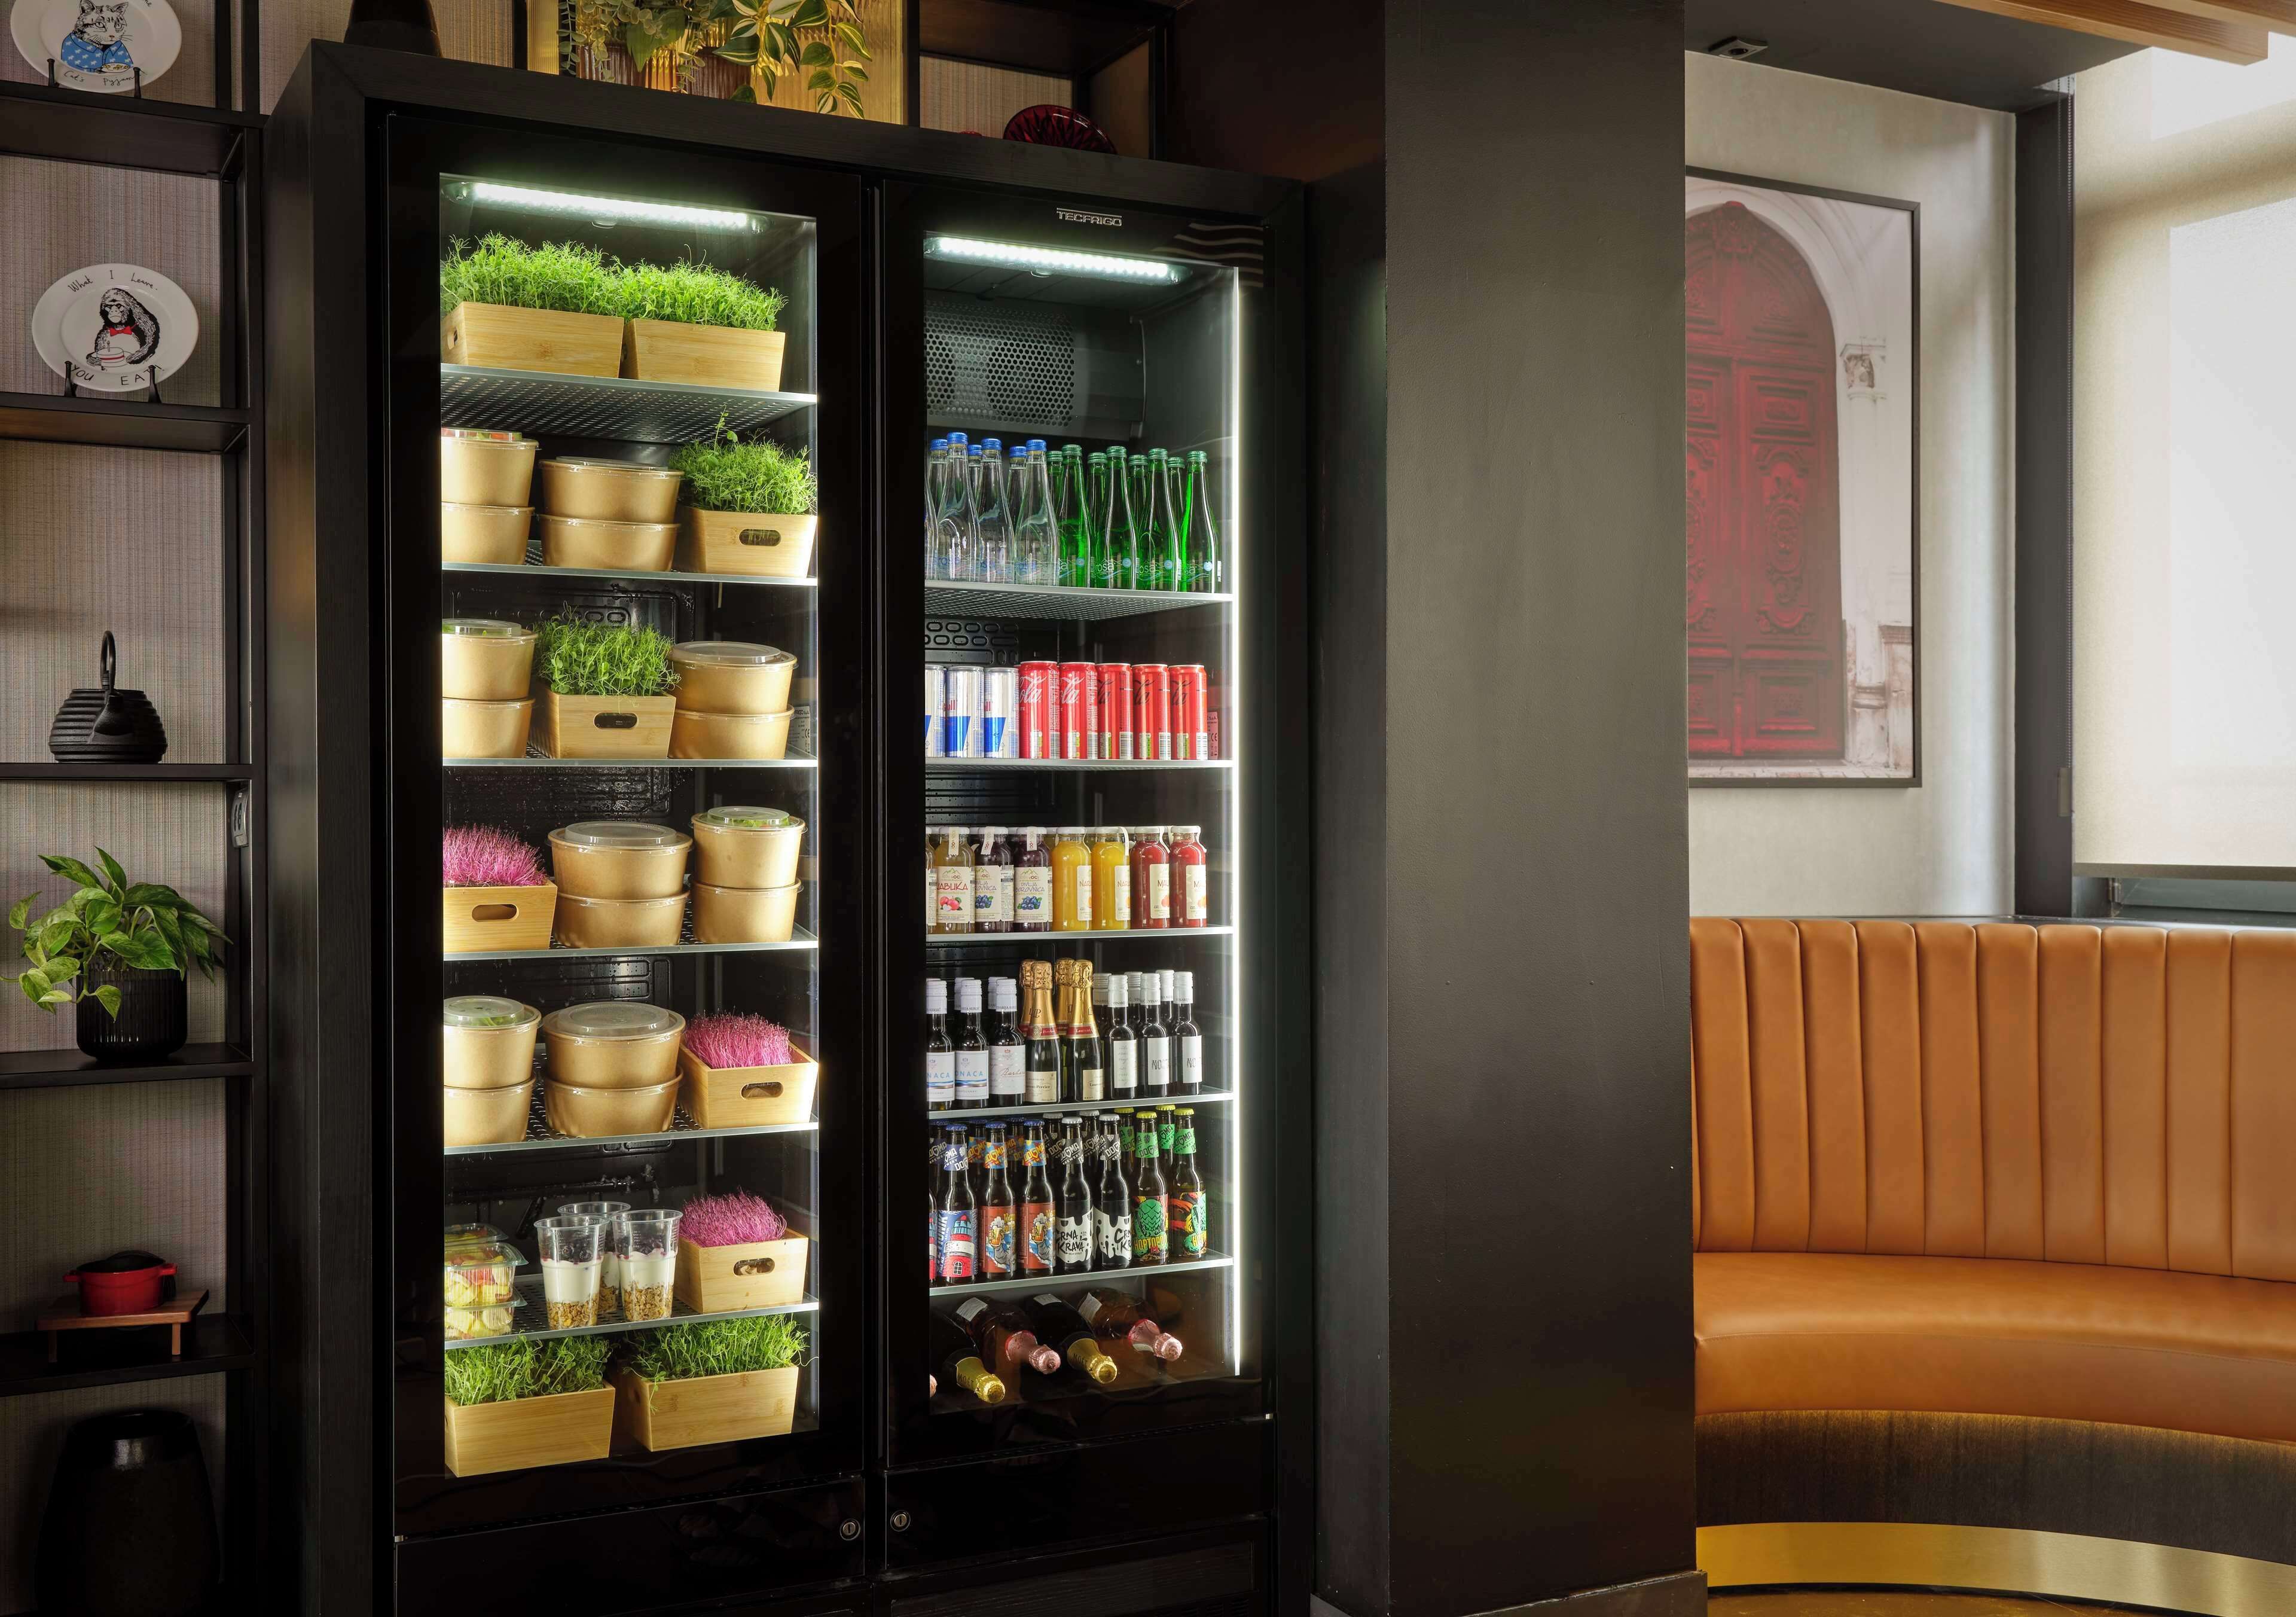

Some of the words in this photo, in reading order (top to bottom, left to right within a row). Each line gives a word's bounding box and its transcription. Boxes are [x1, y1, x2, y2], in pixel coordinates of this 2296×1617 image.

[1057, 210, 1122, 227] TECFRIGO
[68, 275, 93, 292] What
[109, 270, 114, 279] I
[71, 364, 95, 382] YOU
[1057, 1229, 1078, 1242] RNA
[1057, 1240, 1085, 1255] KRAVA
